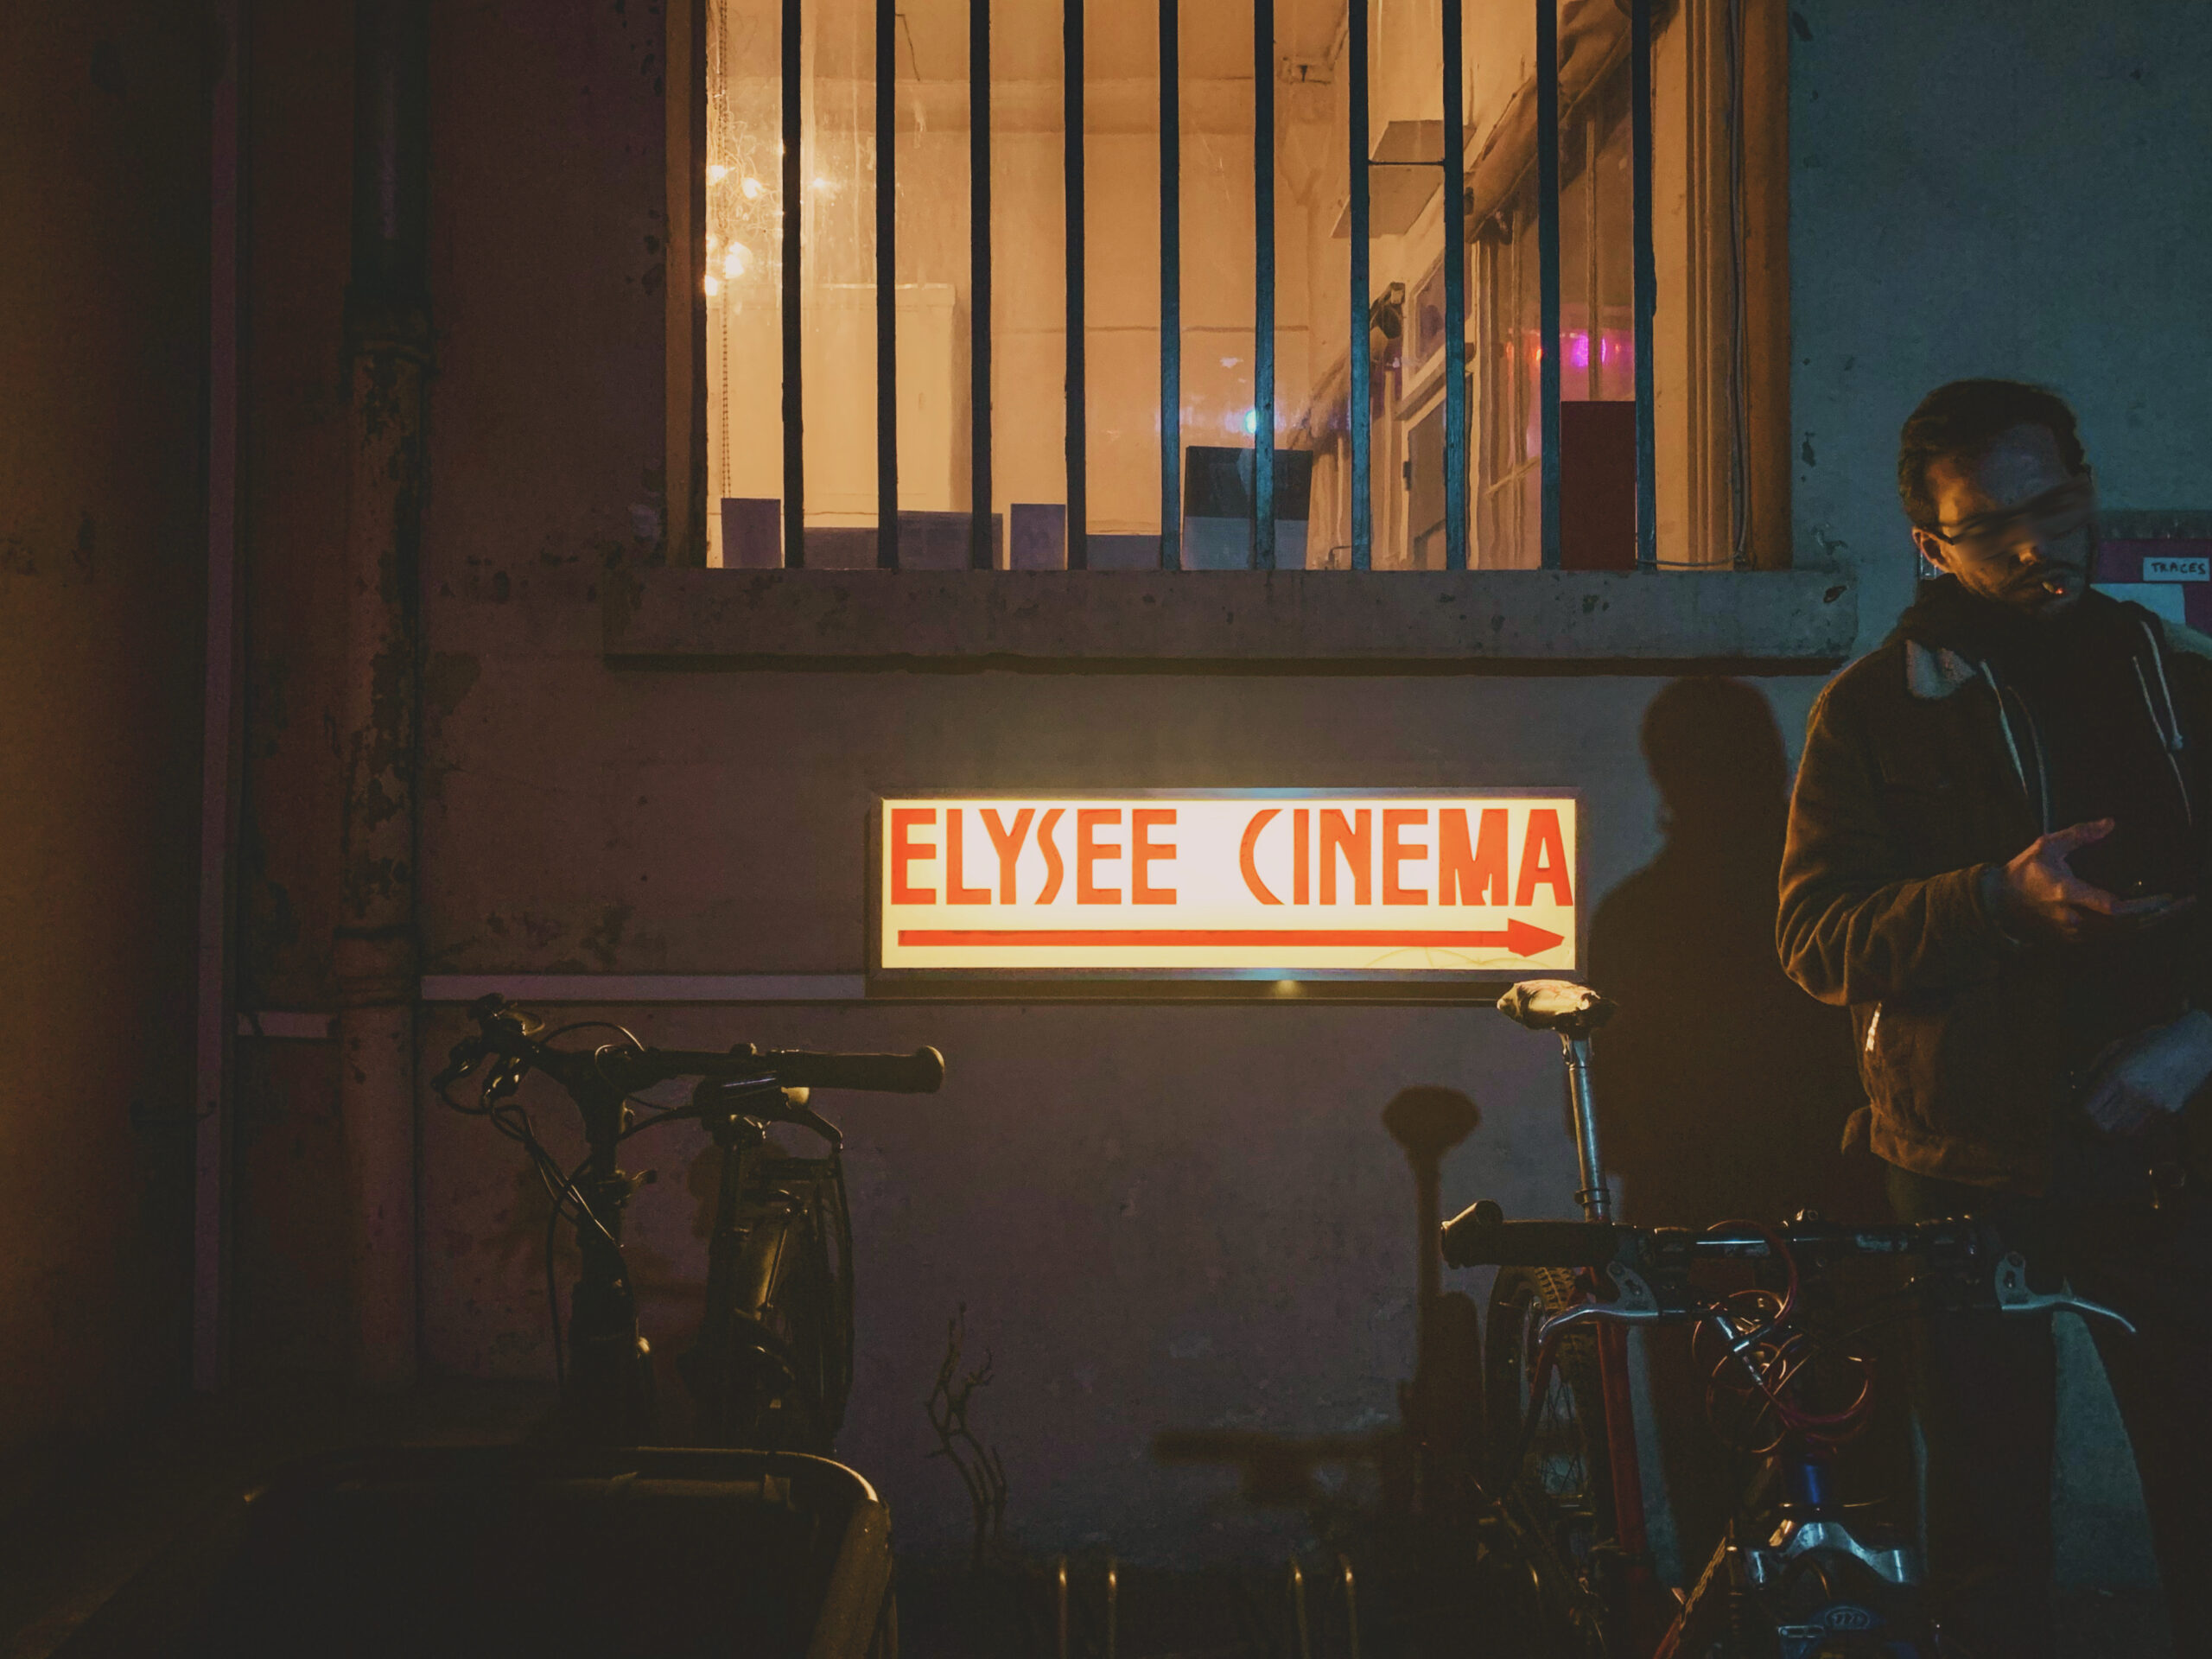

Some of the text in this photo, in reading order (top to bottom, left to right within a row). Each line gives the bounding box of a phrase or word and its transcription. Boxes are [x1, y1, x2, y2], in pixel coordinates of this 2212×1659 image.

[2151, 562, 2206, 575] TRACES
[891, 808, 1573, 906] ELYSEE CINEMA
